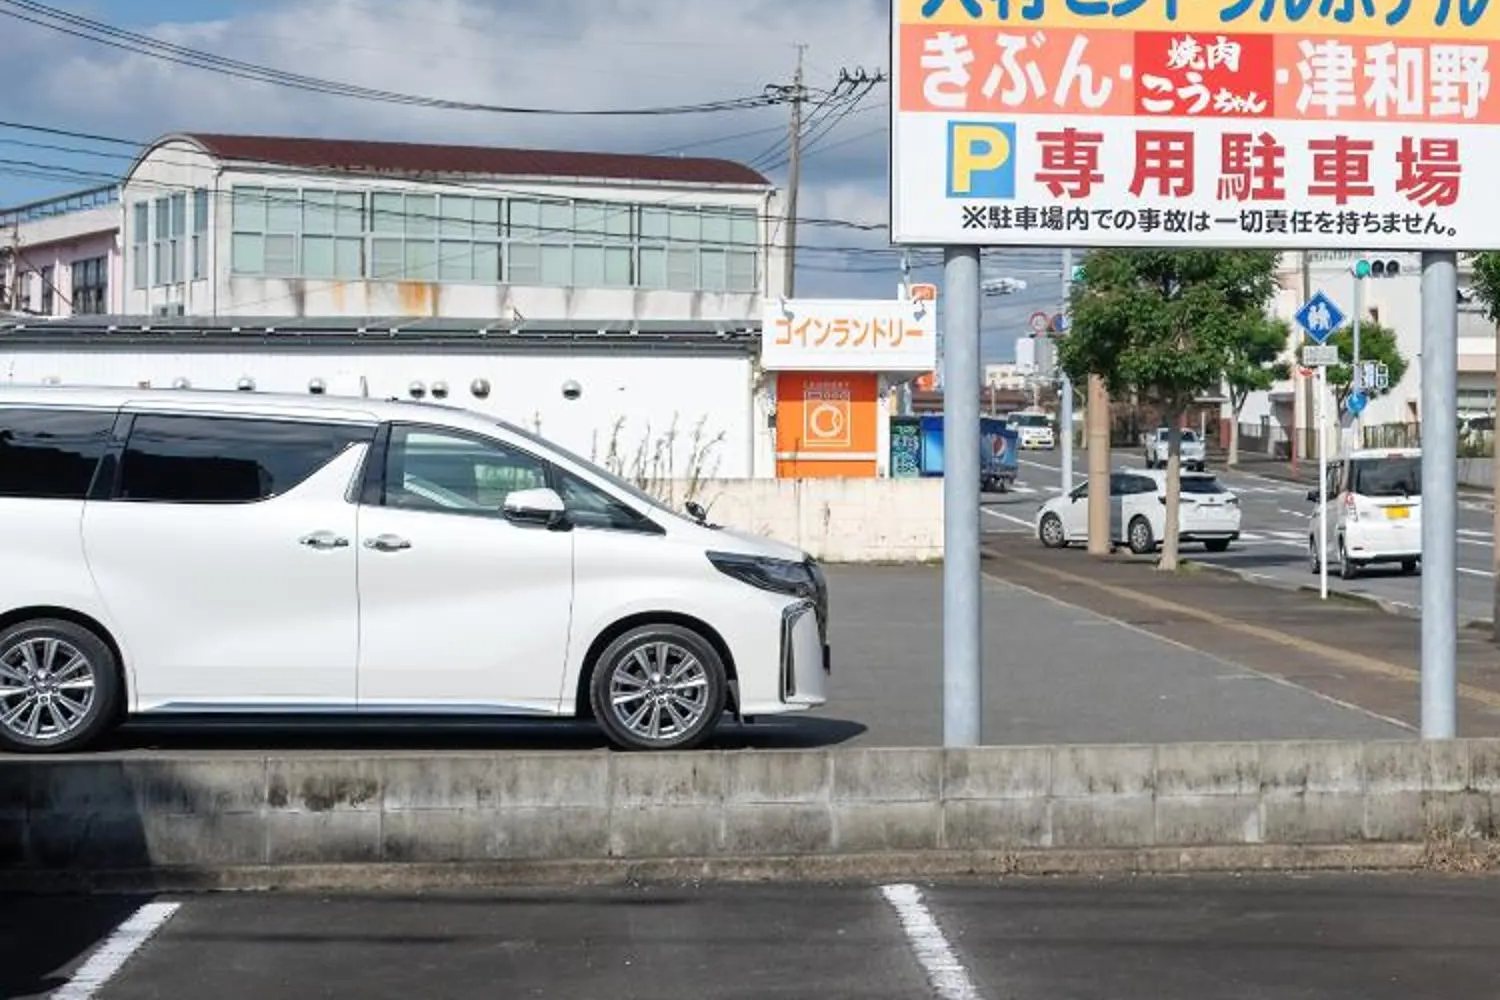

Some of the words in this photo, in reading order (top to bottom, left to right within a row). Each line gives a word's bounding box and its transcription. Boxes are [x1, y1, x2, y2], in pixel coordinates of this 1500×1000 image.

[1166, 34, 1241, 72] 焼肉
[1141, 71, 1267, 114] こうちゃん
[951, 126, 1010, 193] P
[1035, 127, 1462, 206] 専用駐車場
[775, 317, 924, 348] コインランドリー
